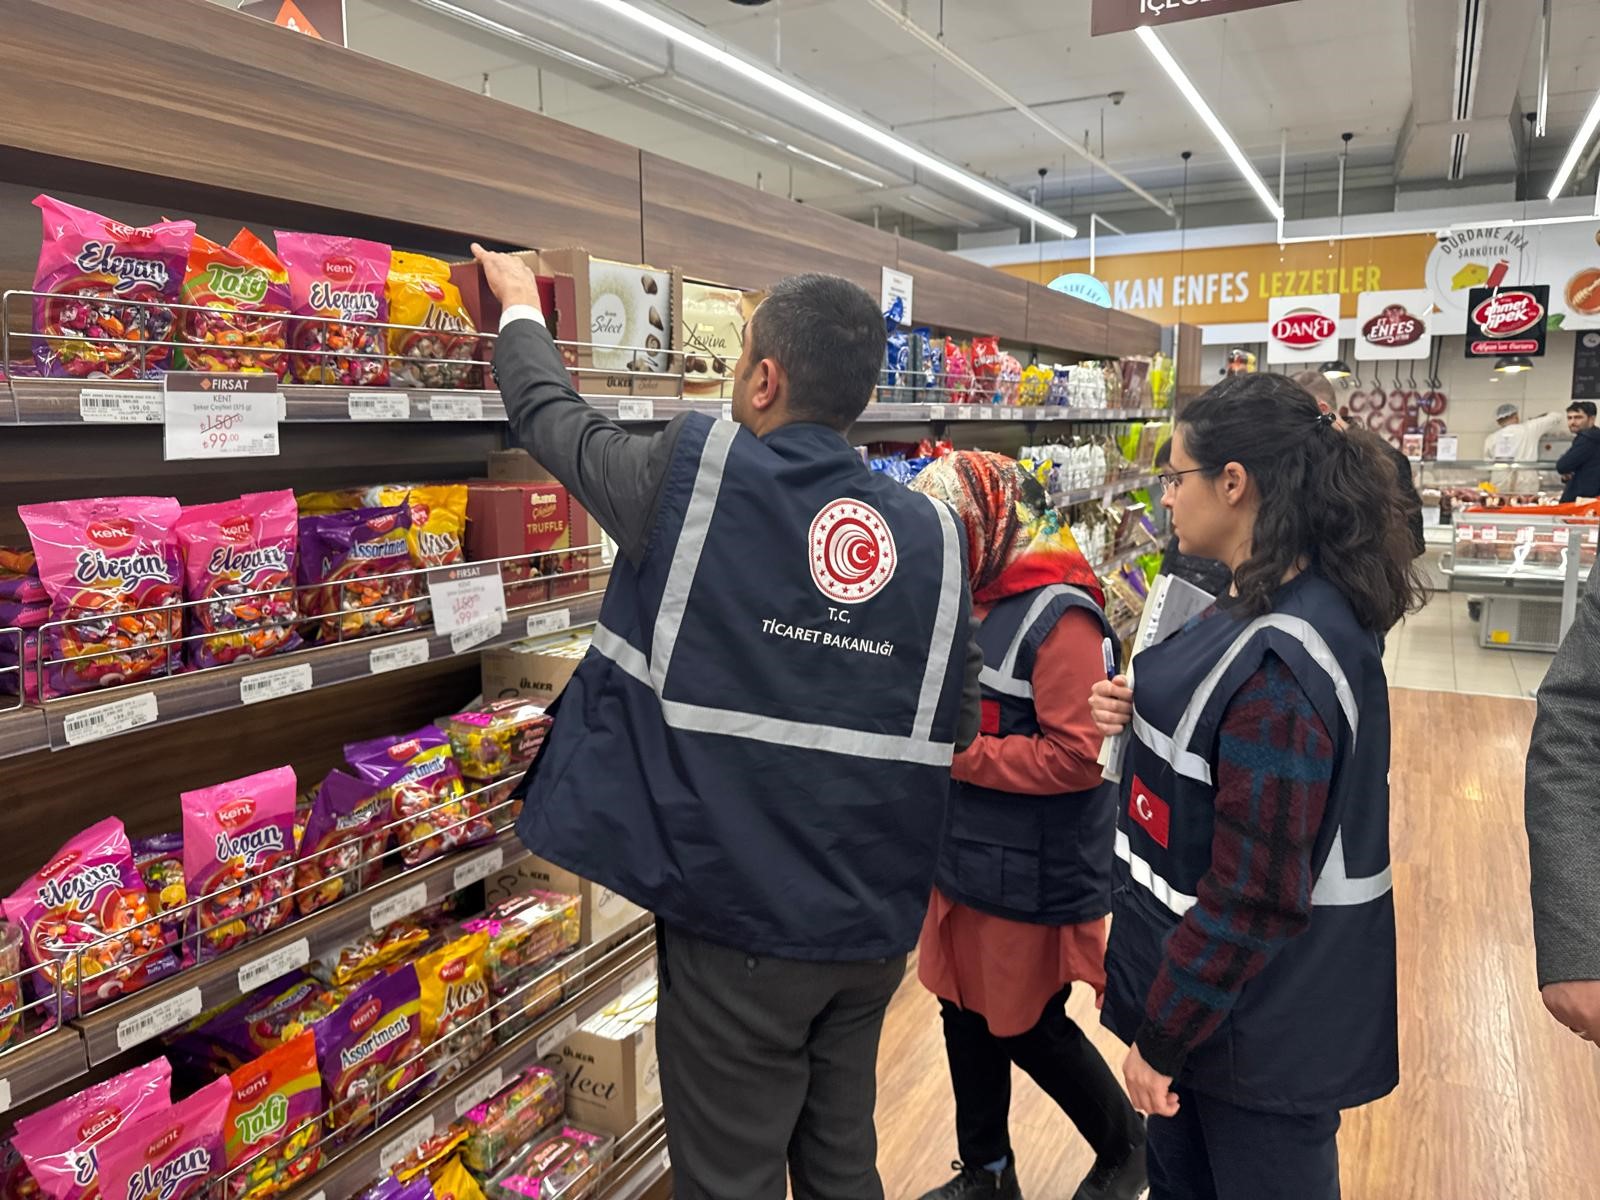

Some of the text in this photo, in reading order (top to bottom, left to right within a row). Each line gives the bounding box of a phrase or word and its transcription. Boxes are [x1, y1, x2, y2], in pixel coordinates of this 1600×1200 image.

[77, 240, 169, 294] Elegan
[326, 261, 353, 274] kent
[1105, 277, 1164, 310] KAN
[1172, 271, 1249, 307] ENFES
[1258, 264, 1382, 299] LEZZETLER
[310, 281, 379, 321] Elegan
[591, 315, 623, 335] Select
[1276, 316, 1333, 340] DANET
[1371, 319, 1415, 339] ENFES
[682, 323, 727, 351] Laviva
[212, 379, 249, 391] FIRSAT
[213, 394, 232, 403] KENT
[91, 527, 130, 539] kent
[221, 522, 250, 536] kent
[526, 520, 564, 535] TRUFFLE
[456, 567, 481, 578] FIRSAT
[827, 607, 850, 624] T.C.
[762, 618, 895, 657] TİCARET BAKANLIĞI
[520, 677, 553, 692] ÜLKER
[218, 803, 252, 821] kent
[352, 1004, 378, 1029] kent
[339, 1013, 411, 1073] Assortment
[237, 1076, 268, 1100] kent
[127, 1146, 211, 1200] Elegan
